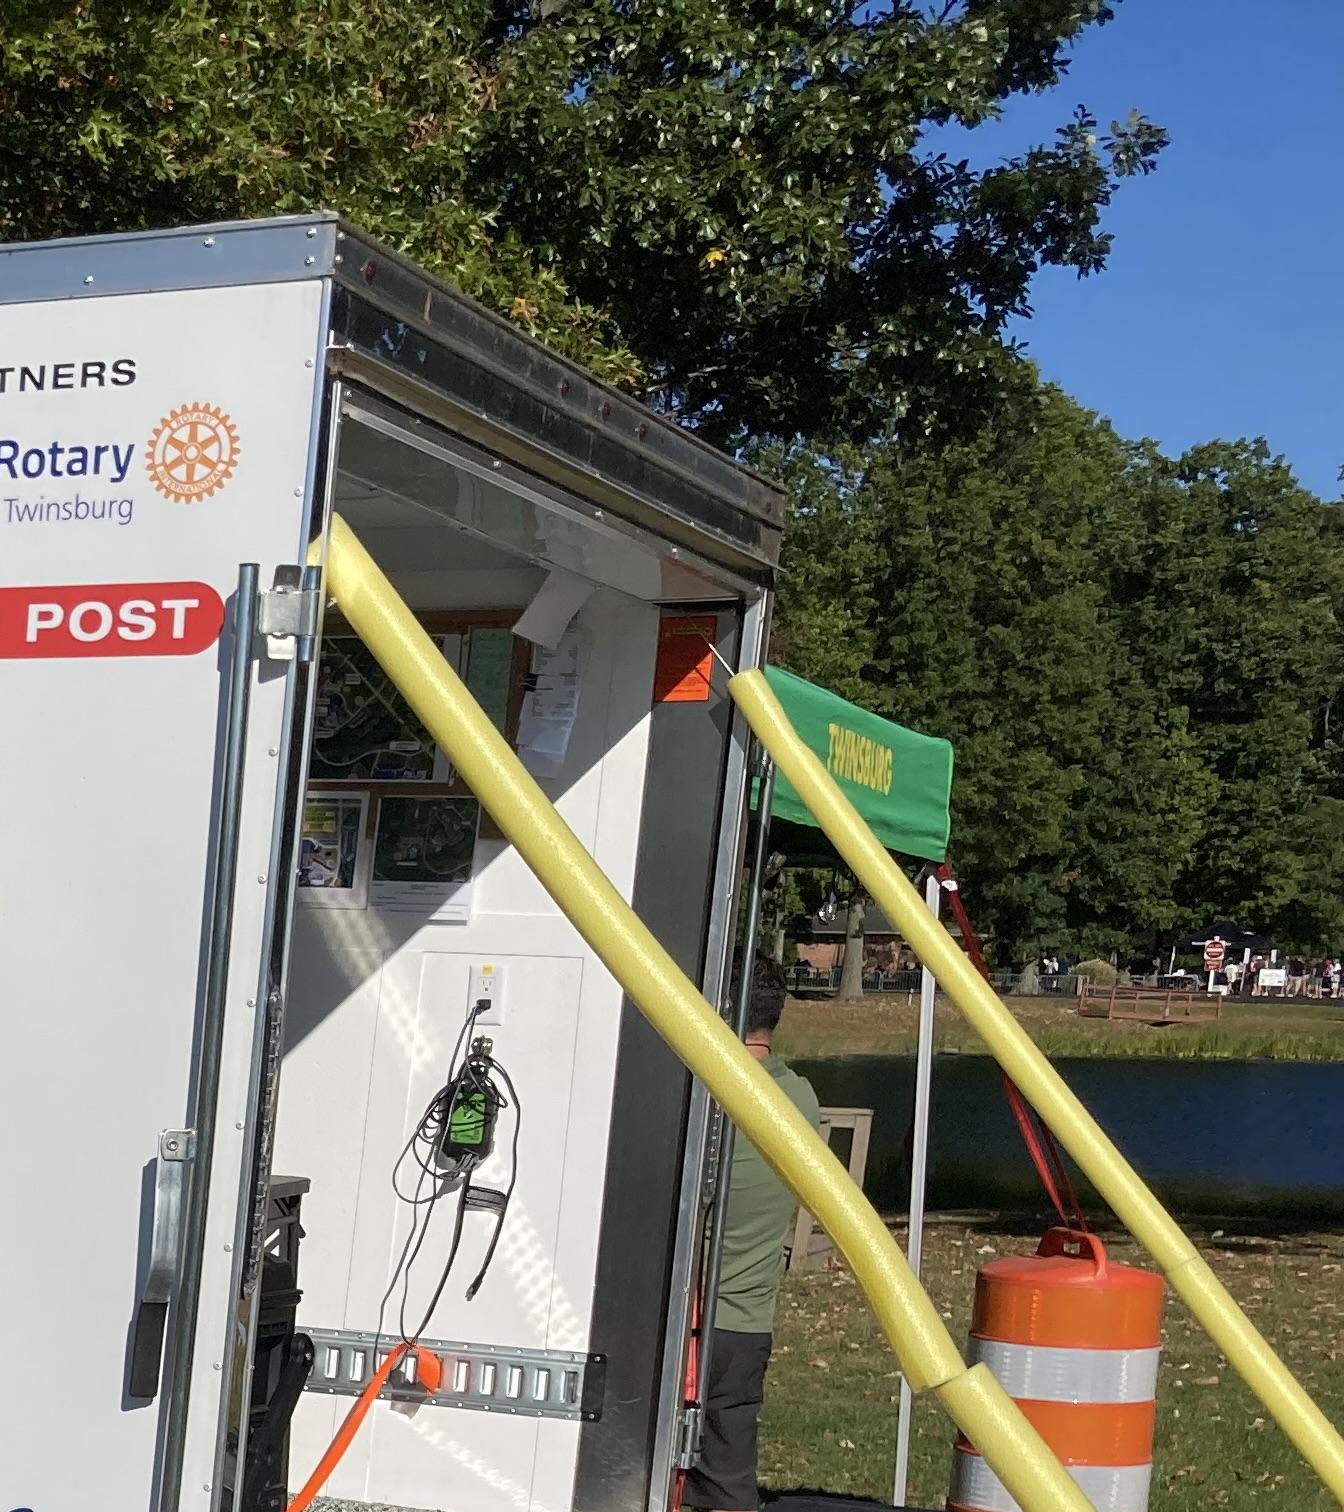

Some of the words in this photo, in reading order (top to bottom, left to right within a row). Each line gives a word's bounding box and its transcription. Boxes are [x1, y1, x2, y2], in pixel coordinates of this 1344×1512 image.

[2, 492, 134, 526] Twinsburg
[25, 597, 200, 643] POST
[828, 723, 892, 795] TWINSBURG
